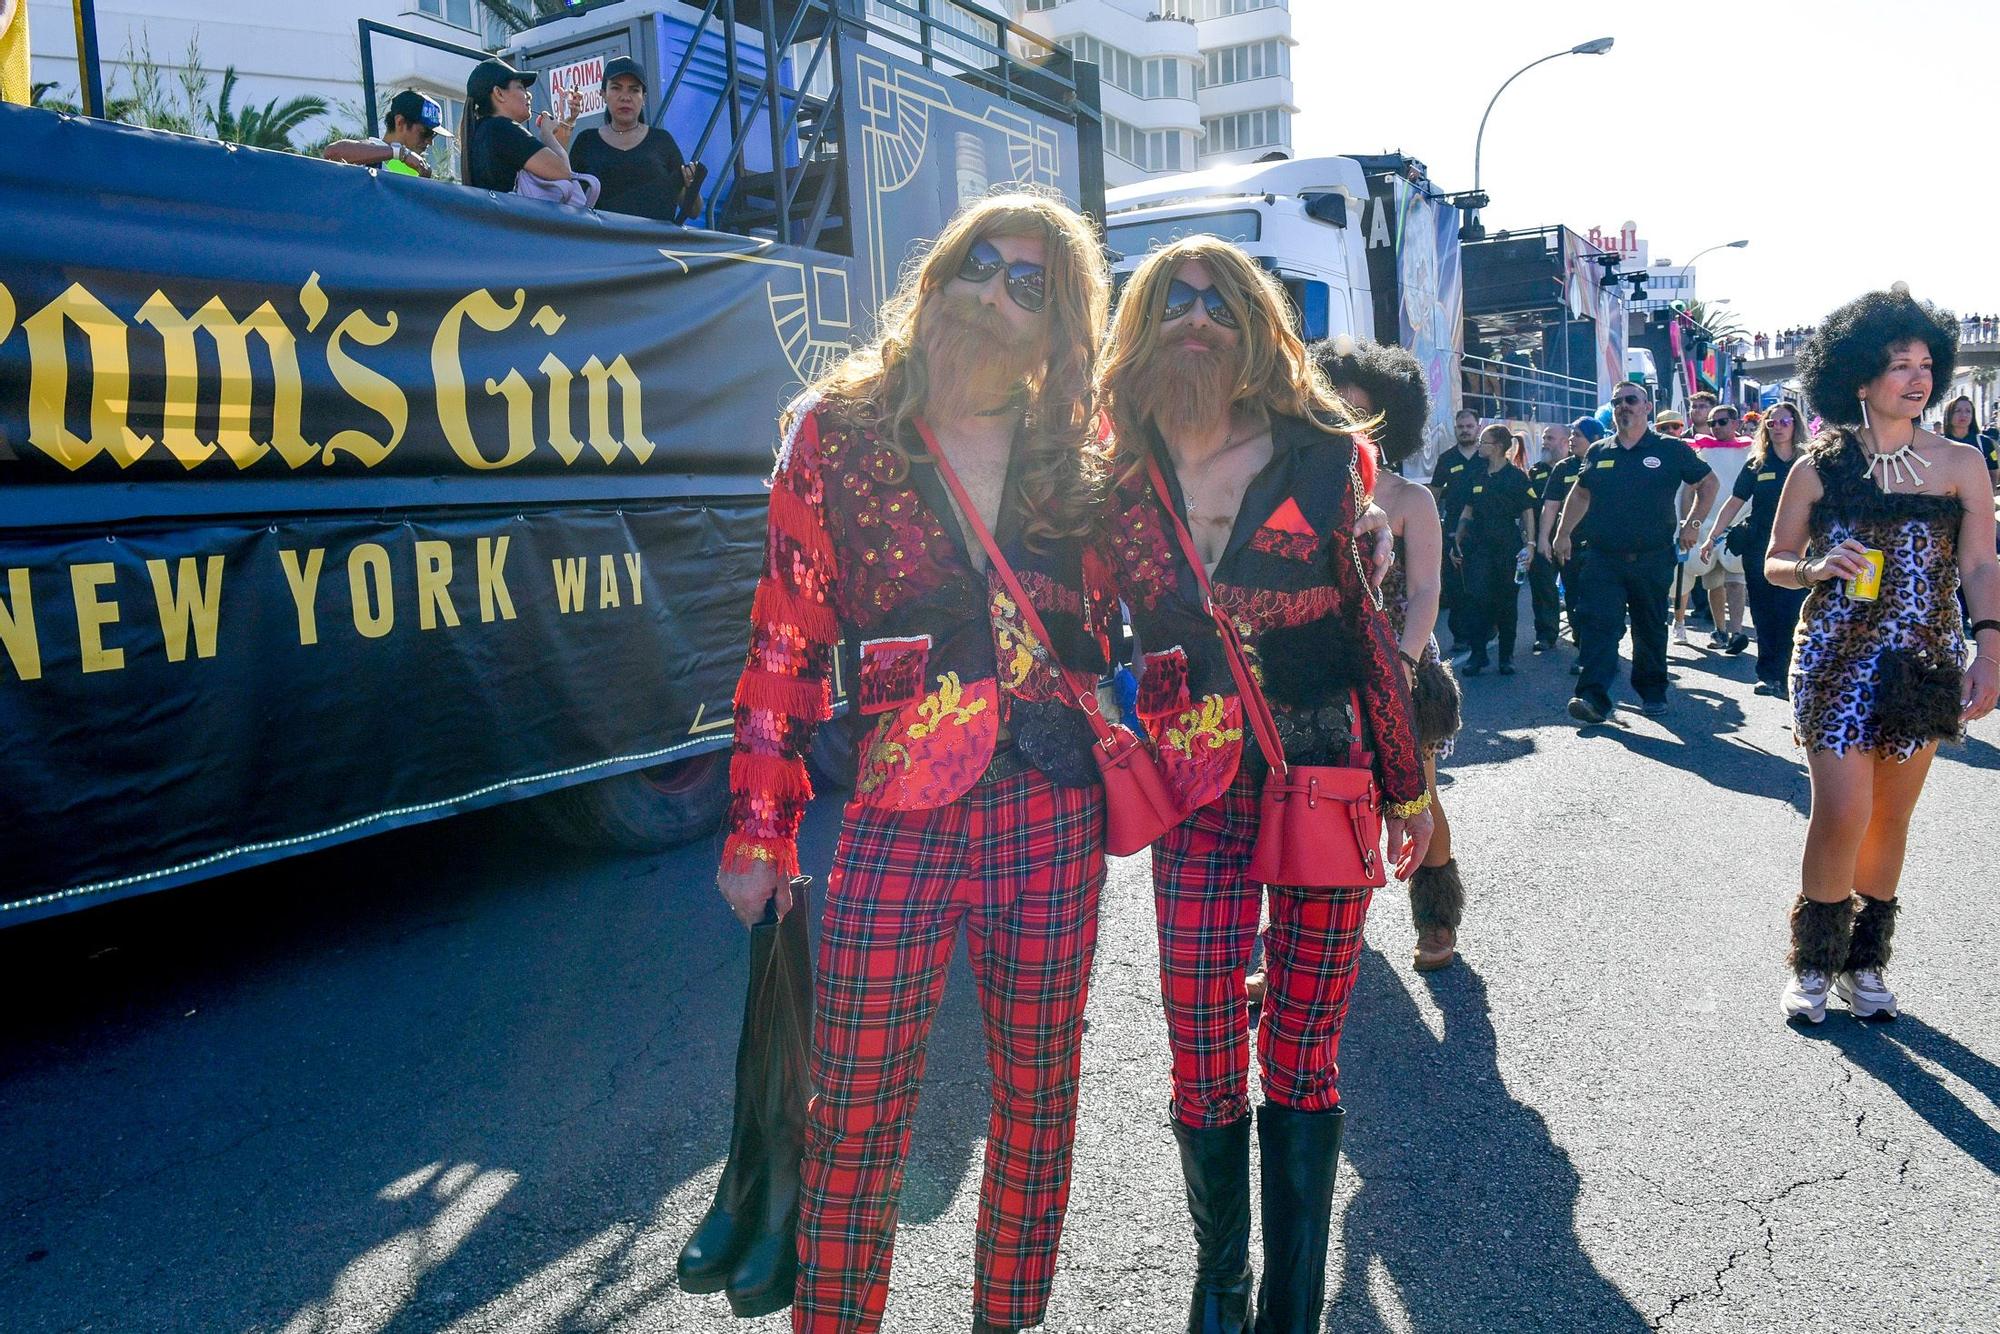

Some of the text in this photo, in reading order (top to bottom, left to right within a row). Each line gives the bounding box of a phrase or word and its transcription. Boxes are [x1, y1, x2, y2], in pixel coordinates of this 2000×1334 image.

[1362, 196, 1391, 249] A
[1588, 228, 1639, 252] Bull
[0, 271, 656, 471] am's Gin
[279, 536, 517, 645] YORK
[552, 553, 643, 614] WAY
